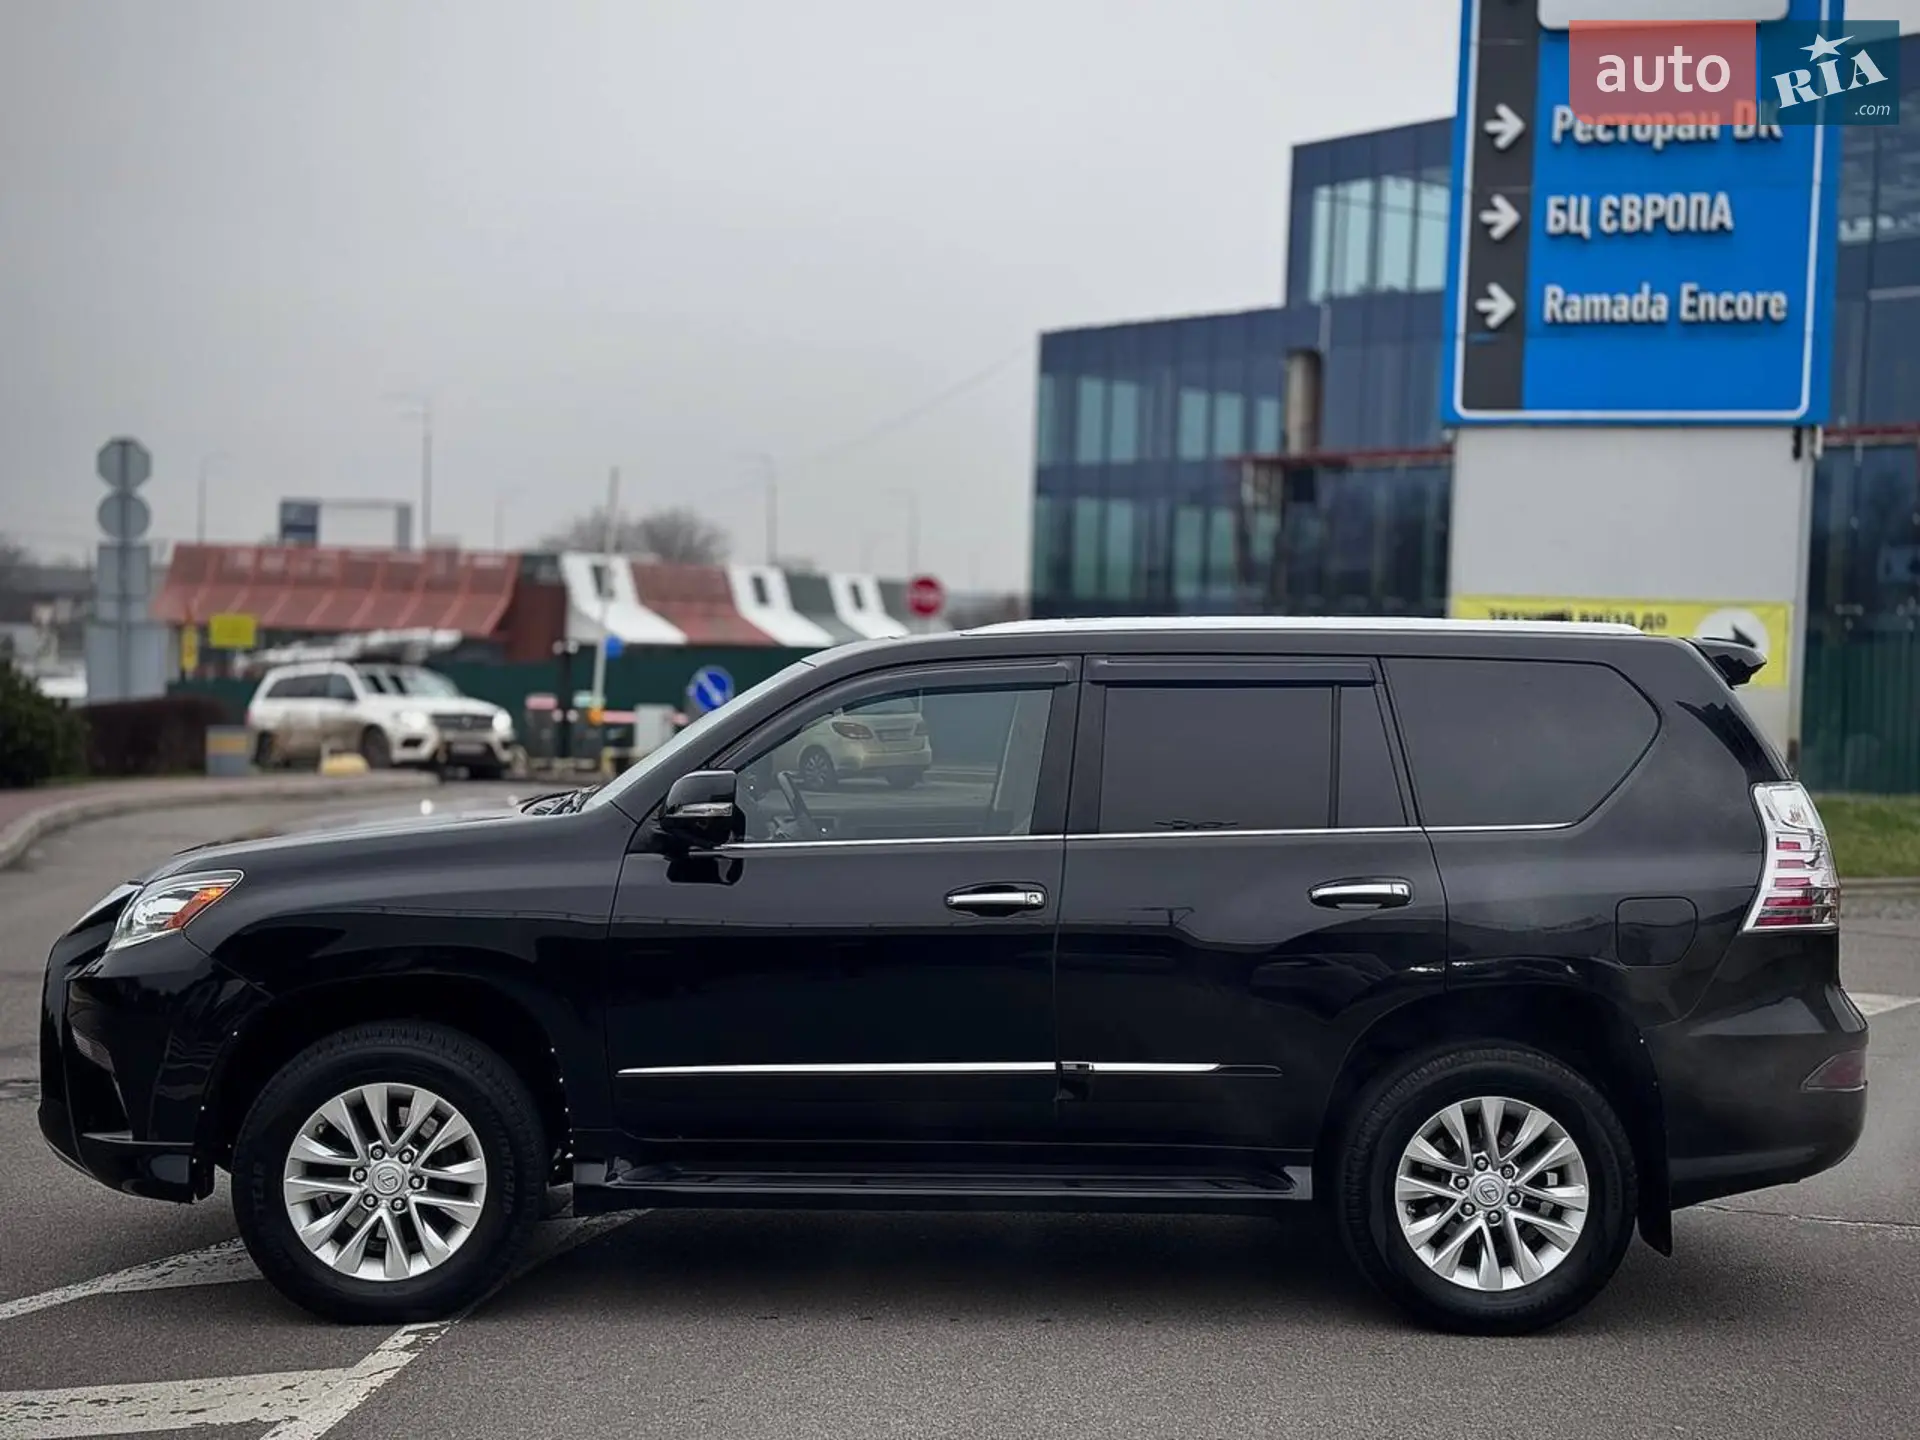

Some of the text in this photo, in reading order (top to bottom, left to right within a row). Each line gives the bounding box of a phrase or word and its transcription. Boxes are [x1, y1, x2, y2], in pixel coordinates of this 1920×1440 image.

[1551, 103, 1721, 149] Ресторан
[1545, 192, 1734, 238] БЦ ЄВРОПА
[1543, 282, 1788, 323] Ramada Encore
